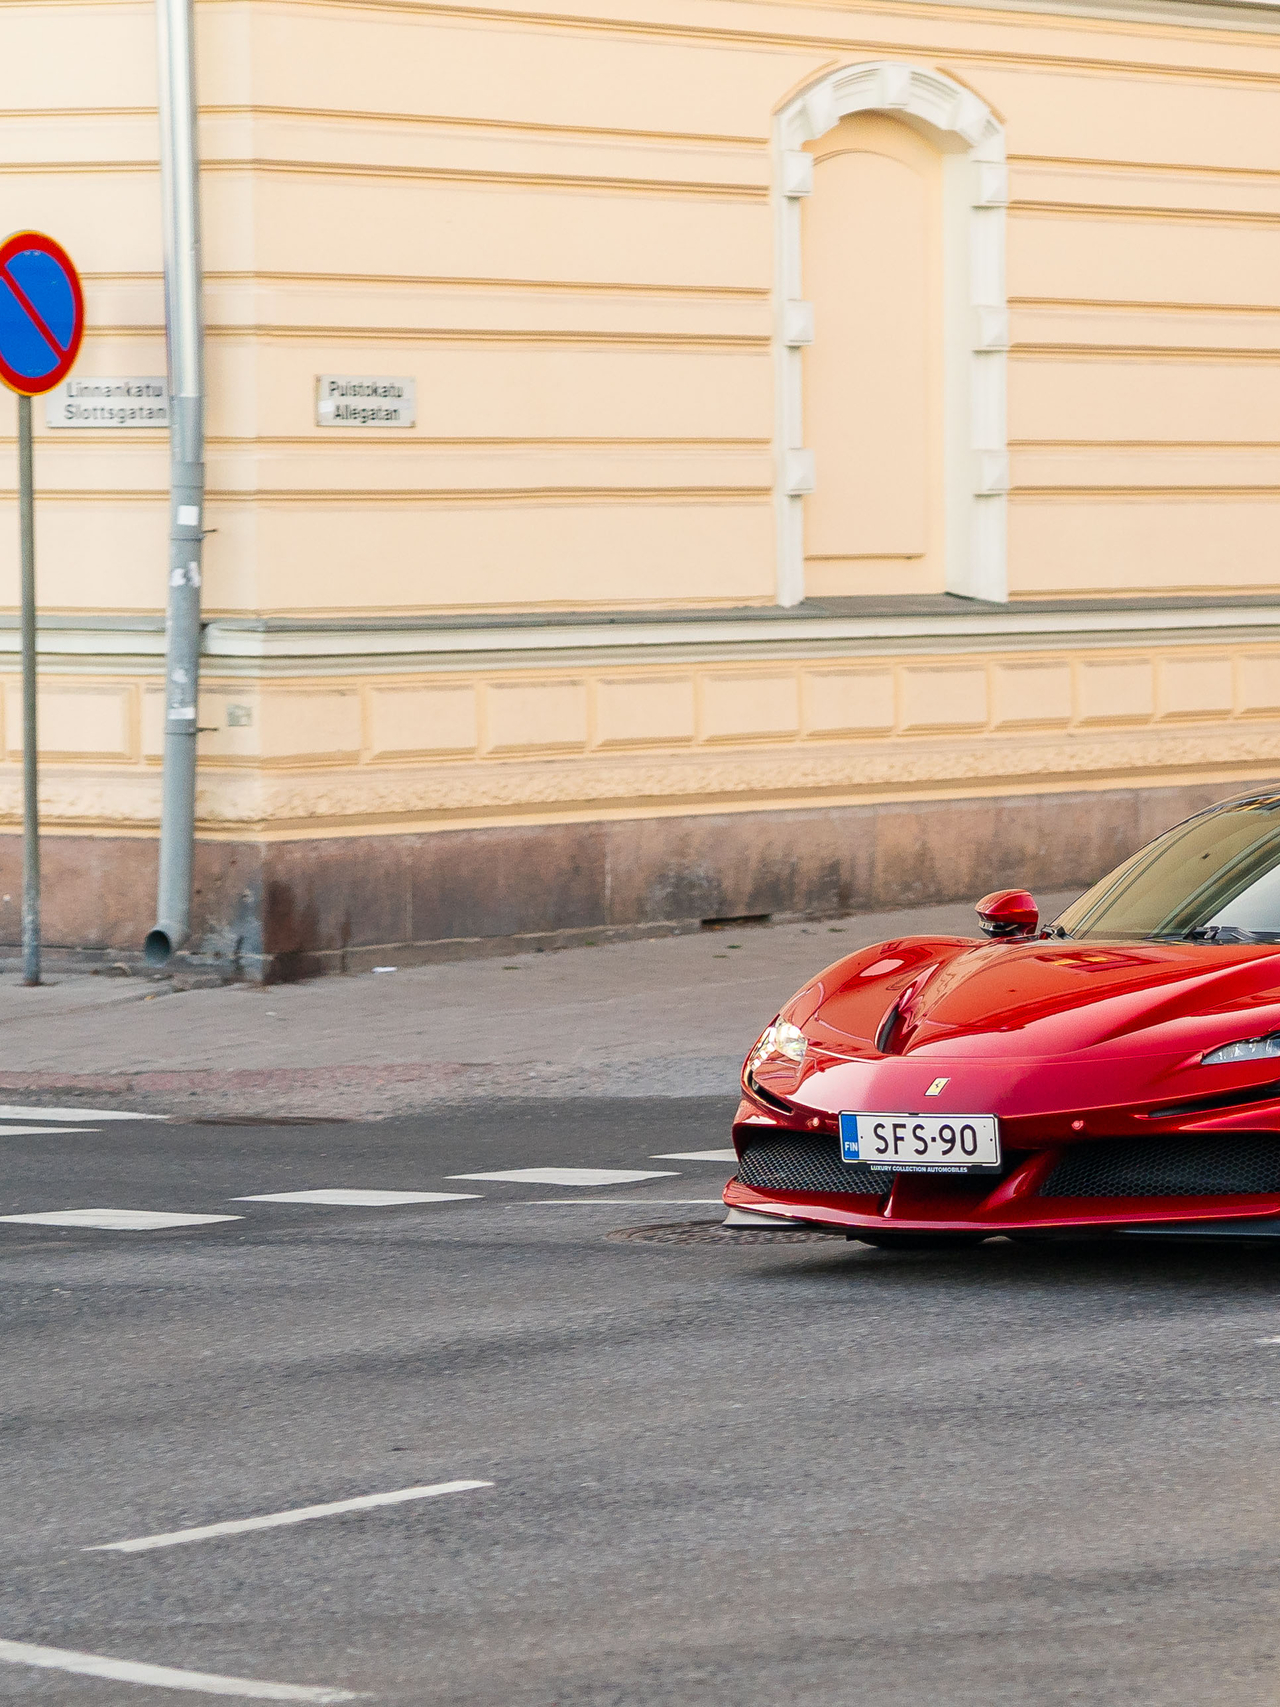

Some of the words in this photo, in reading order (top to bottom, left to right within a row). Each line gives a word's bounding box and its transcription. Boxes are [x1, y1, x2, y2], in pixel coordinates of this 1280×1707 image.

[66, 382, 162, 398] Linnankatu
[328, 381, 403, 398] Puistokatu
[64, 404, 166, 424] Slottsgatan
[844, 1141, 858, 1152] FIN
[873, 1122, 978, 1156] SFS-90
